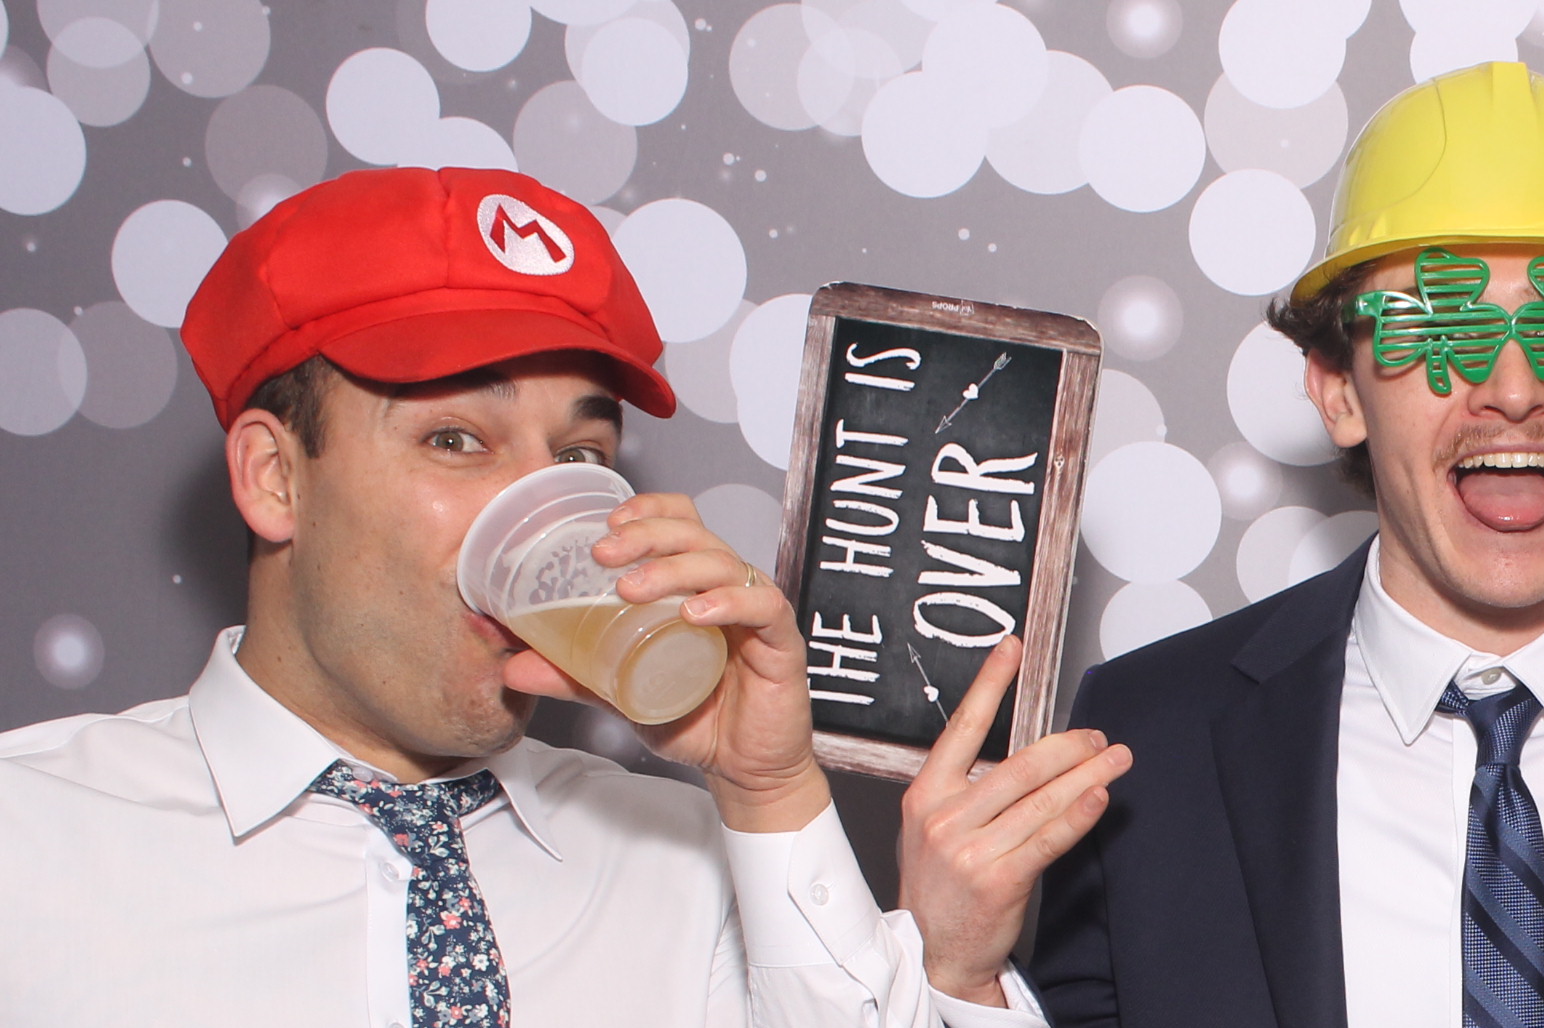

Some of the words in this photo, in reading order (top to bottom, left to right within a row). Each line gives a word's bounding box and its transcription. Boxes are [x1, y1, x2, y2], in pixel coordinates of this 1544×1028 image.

[490, 203, 567, 264] M
[931, 300, 960, 312] PROPS
[844, 342, 922, 391] IS
[819, 418, 909, 578] HUNT
[913, 442, 1039, 648] OVER
[806, 610, 883, 706] THE
